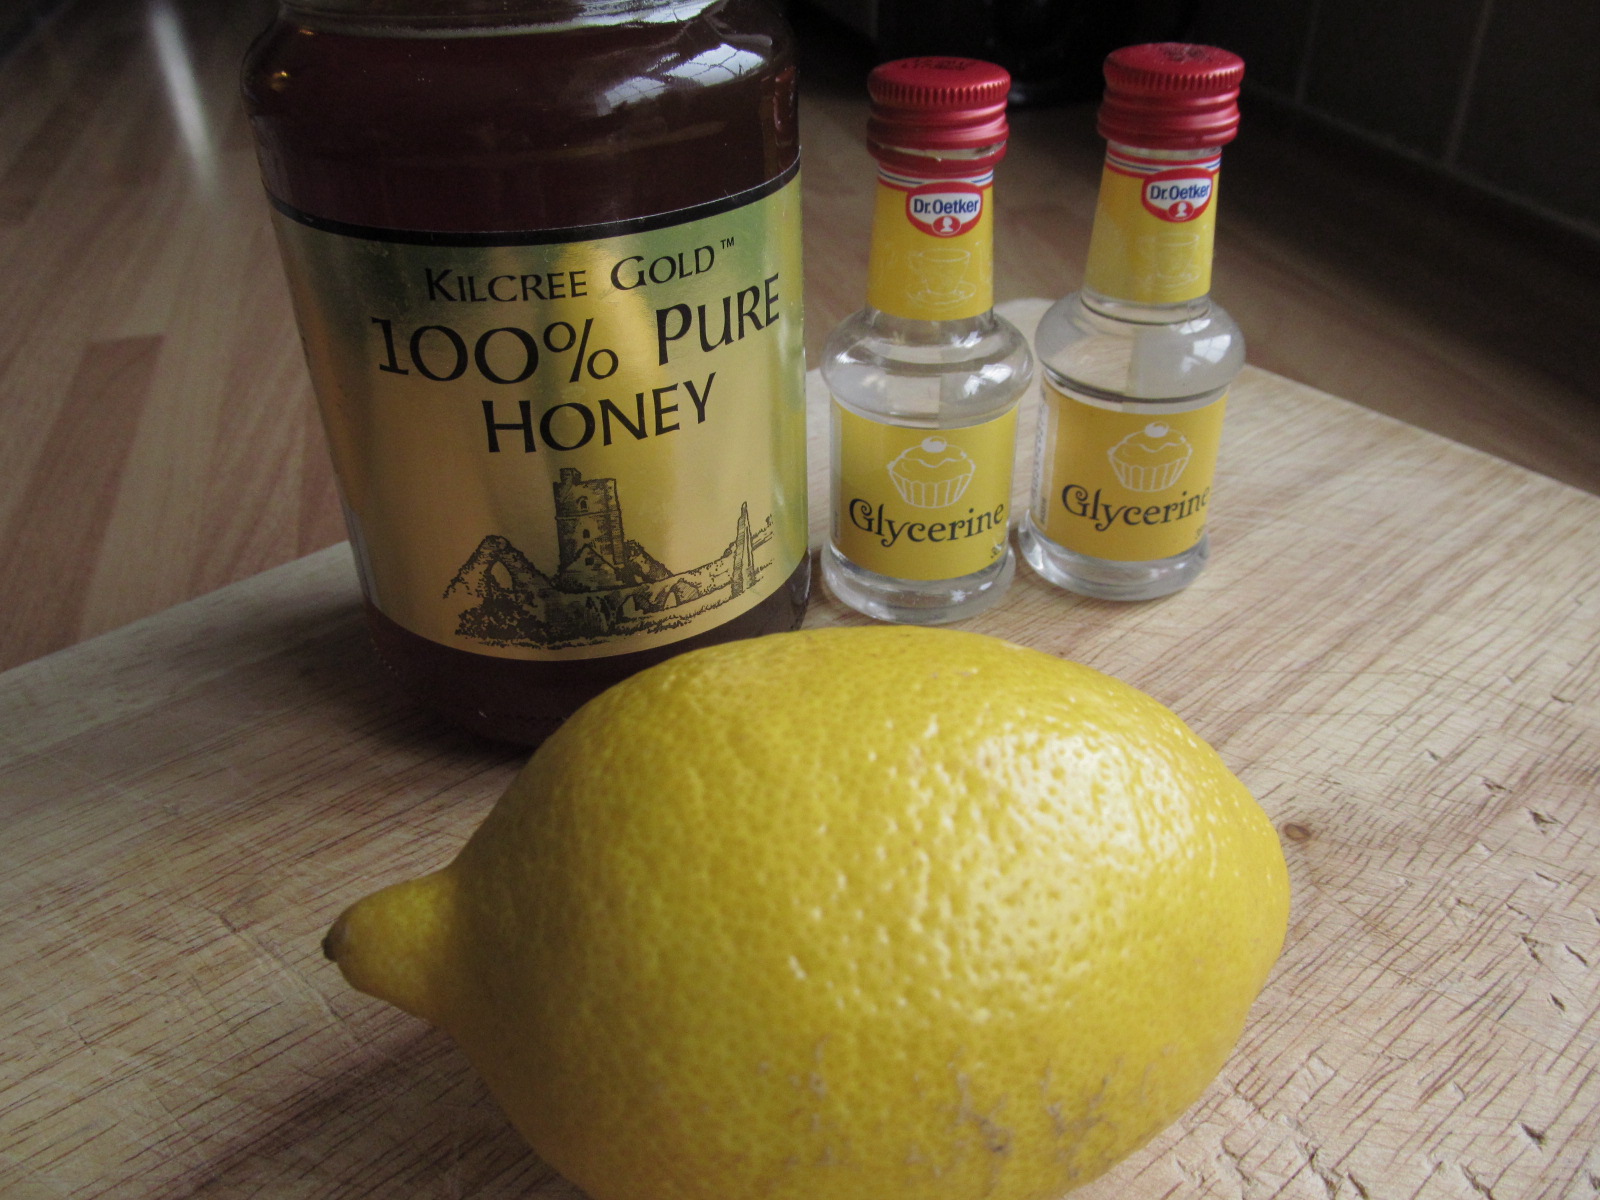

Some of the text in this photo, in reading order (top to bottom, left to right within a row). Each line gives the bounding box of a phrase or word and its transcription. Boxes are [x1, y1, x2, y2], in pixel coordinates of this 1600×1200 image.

[425, 268, 588, 303] KILCREE
[610, 245, 715, 291] GOLD
[371, 273, 780, 385] 100% PURE
[481, 372, 717, 454] HONEY
[849, 498, 1004, 548] Glycerine
